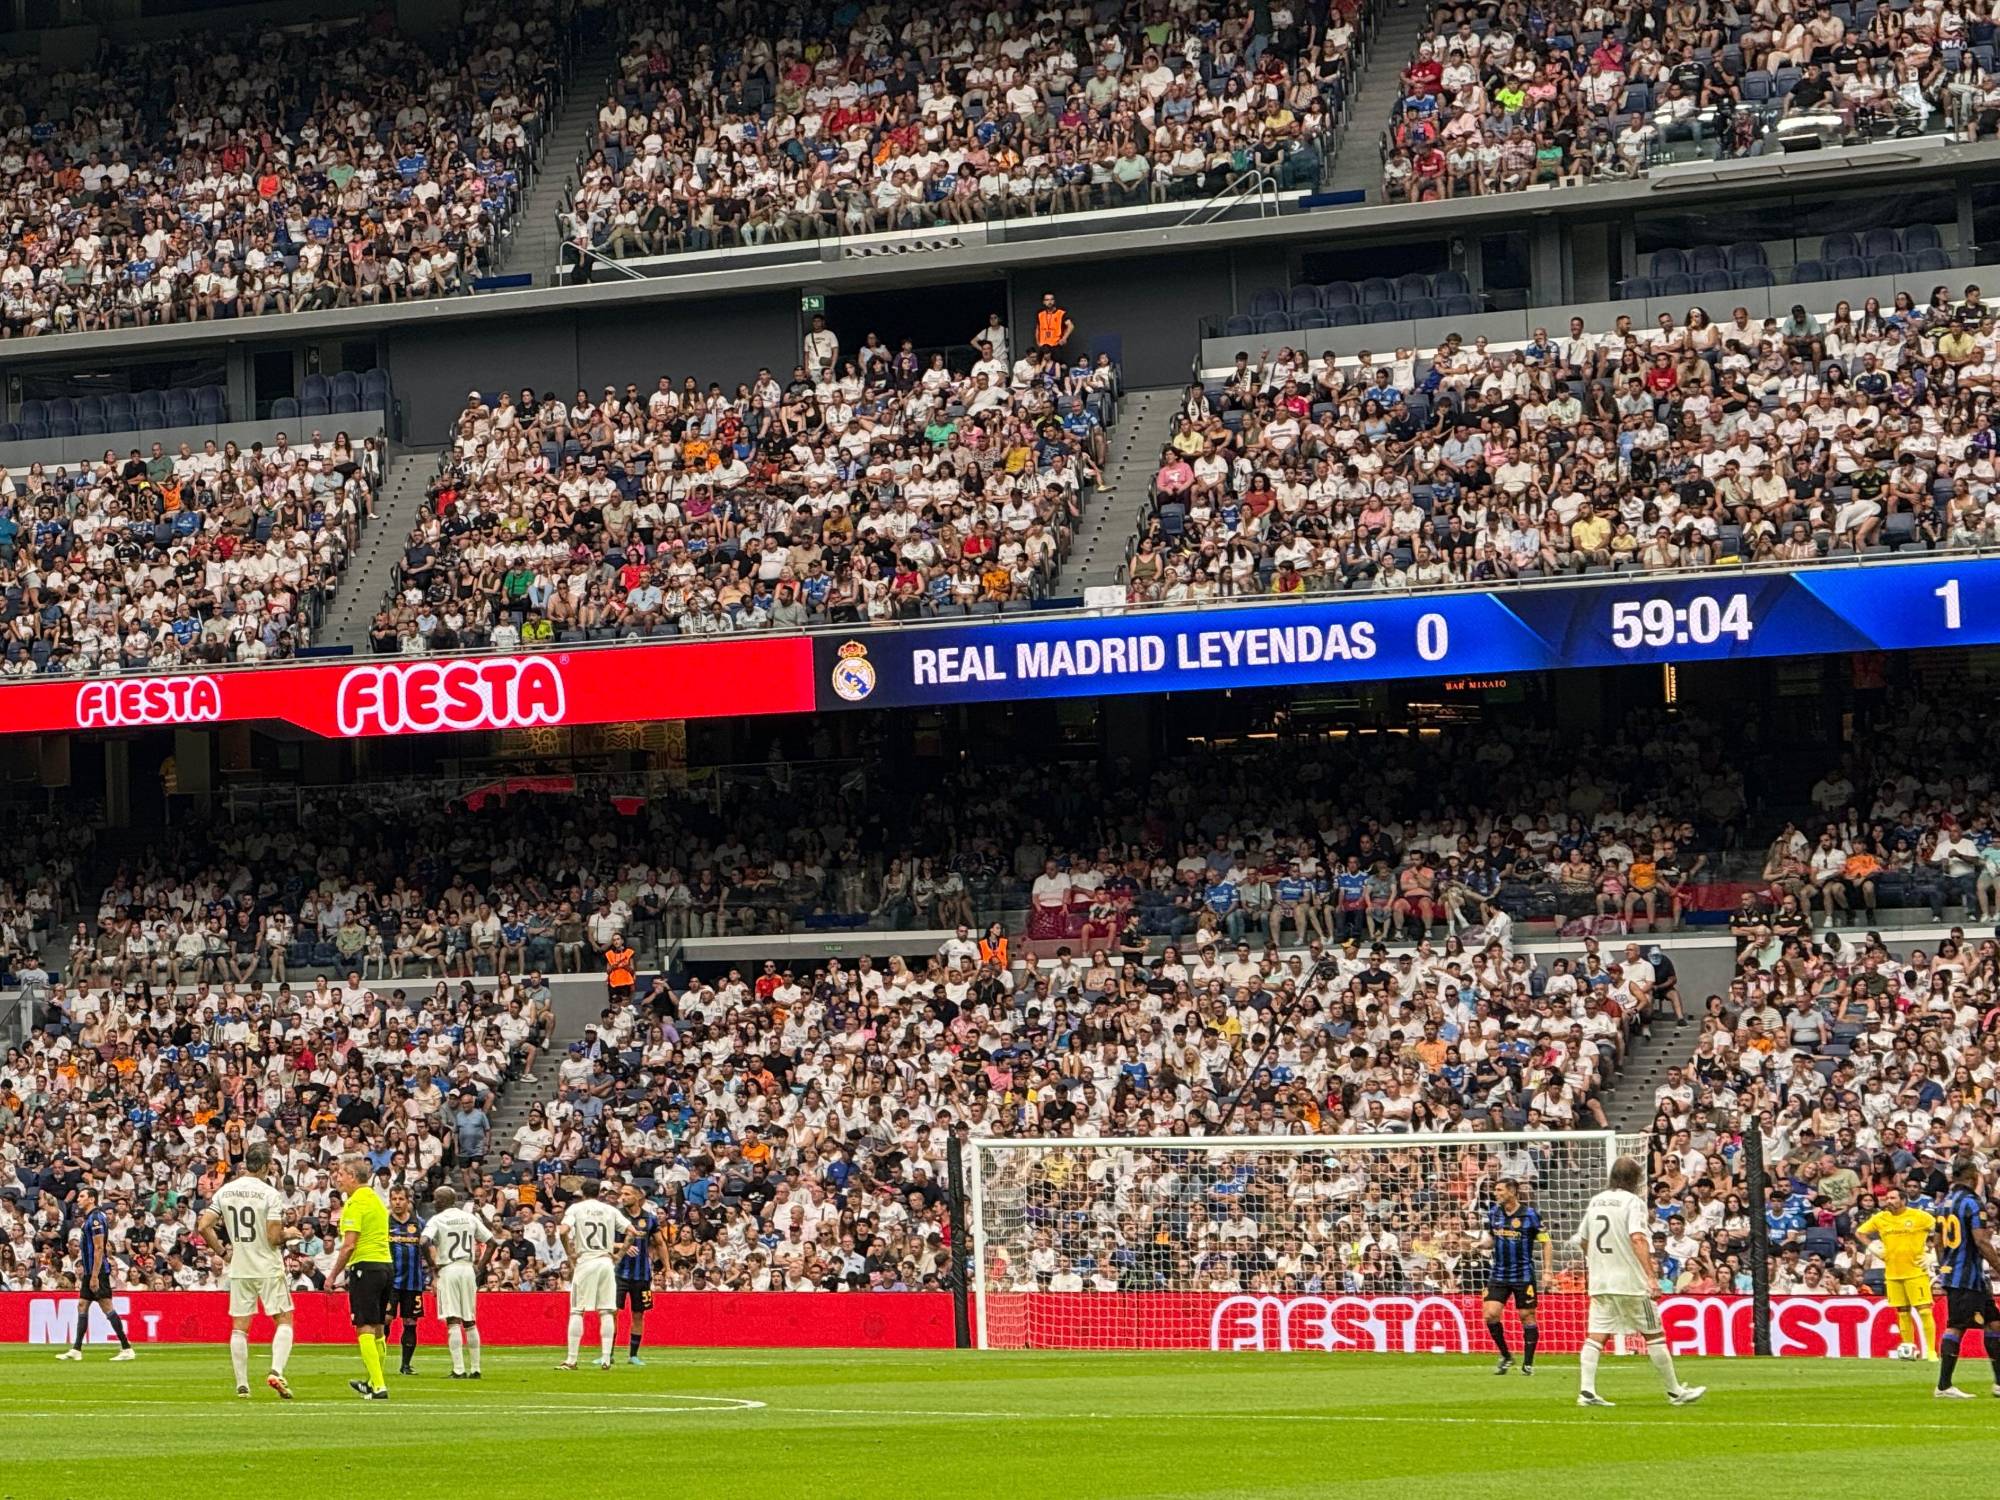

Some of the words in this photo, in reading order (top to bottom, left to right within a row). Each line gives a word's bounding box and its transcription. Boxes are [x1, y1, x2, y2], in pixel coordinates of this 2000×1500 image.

[1612, 594, 1752, 648] 59:04
[1935, 579, 1961, 629] 1
[913, 645, 1006, 685] REAL
[1017, 635, 1166, 680] MADRID
[1178, 621, 1377, 670] LEYENDAS
[1416, 613, 1449, 661] 0
[75, 675, 221, 727] FIESTA
[337, 656, 566, 736] FIESTA
[227, 1206, 257, 1242] 19
[447, 1230, 473, 1262] 24
[584, 1221, 608, 1251] 21
[1595, 1214, 1613, 1254] 2
[415, 1295, 422, 1309] 5
[1526, 1284, 1535, 1297] 4
[1211, 1295, 1470, 1352] FIESTA
